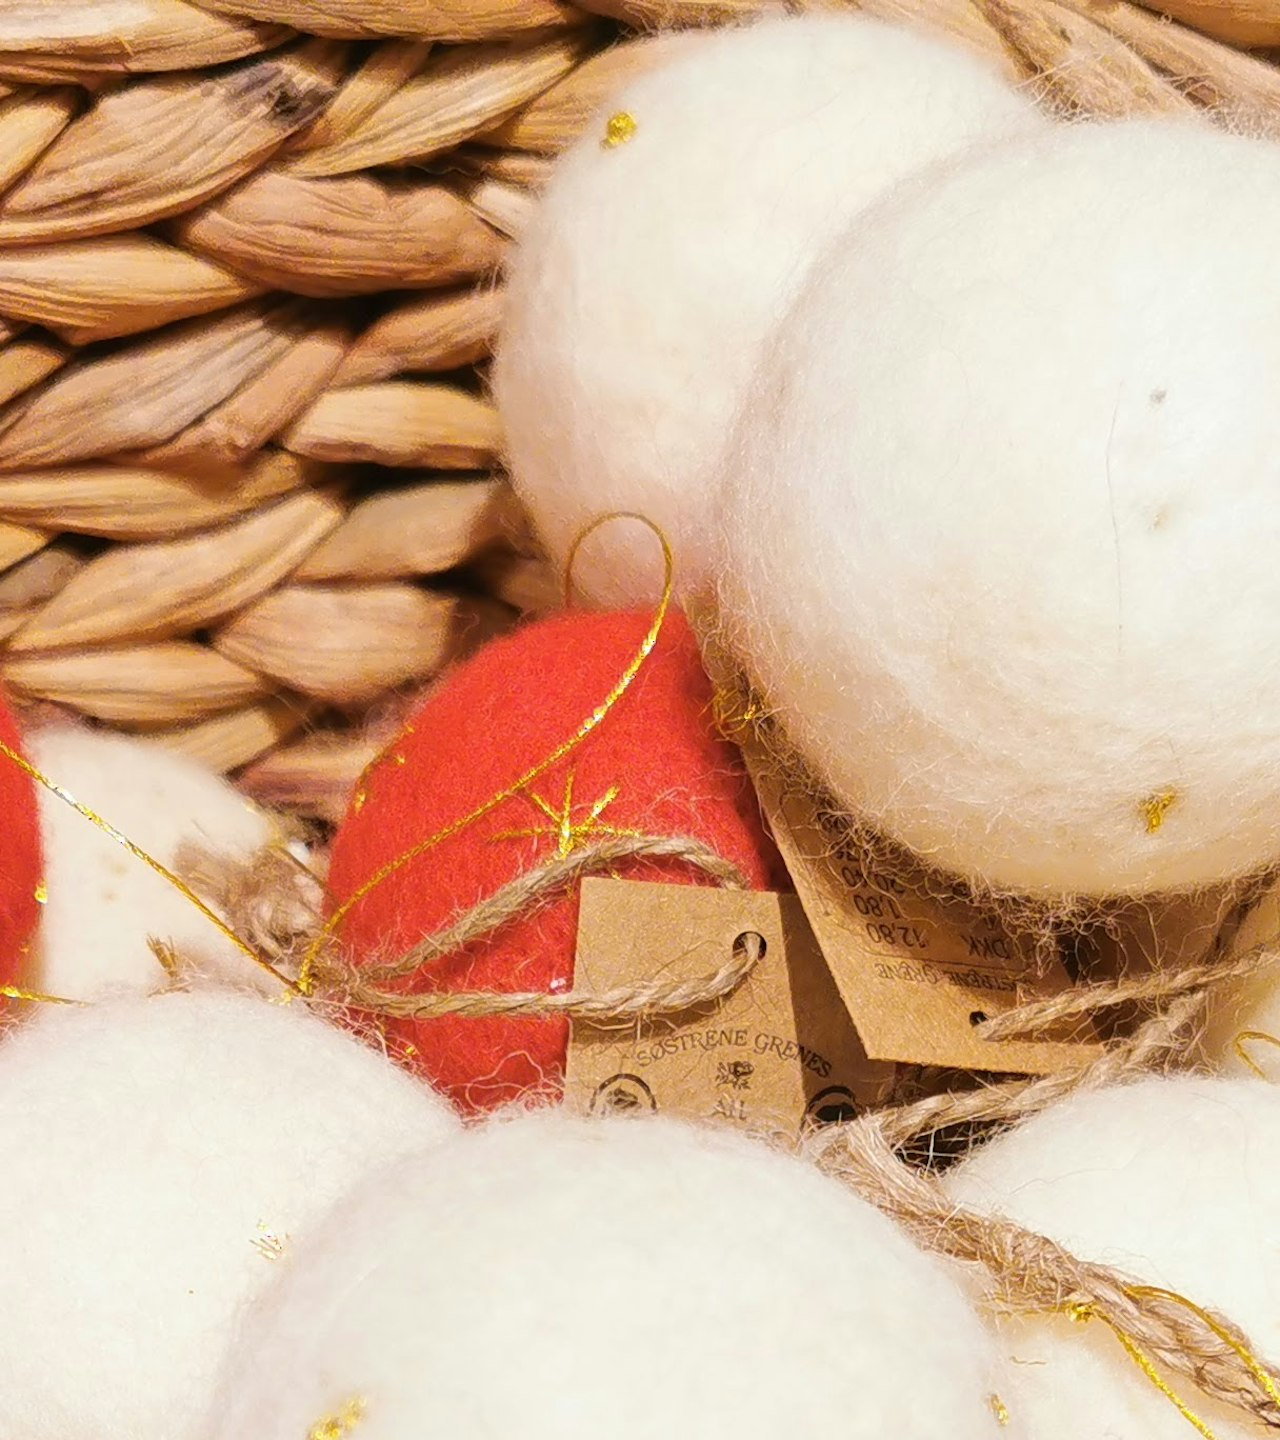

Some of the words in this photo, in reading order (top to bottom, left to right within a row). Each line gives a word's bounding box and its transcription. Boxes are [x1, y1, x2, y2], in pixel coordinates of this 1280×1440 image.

[852, 894, 901, 920] 1,80
[866, 923, 928, 949] 12,80
[961, 935, 1011, 960] DKK
[942, 969, 1017, 992] STRENE
[635, 1029, 749, 1067] SØSTRENE
[753, 1033, 833, 1079] GRENES
